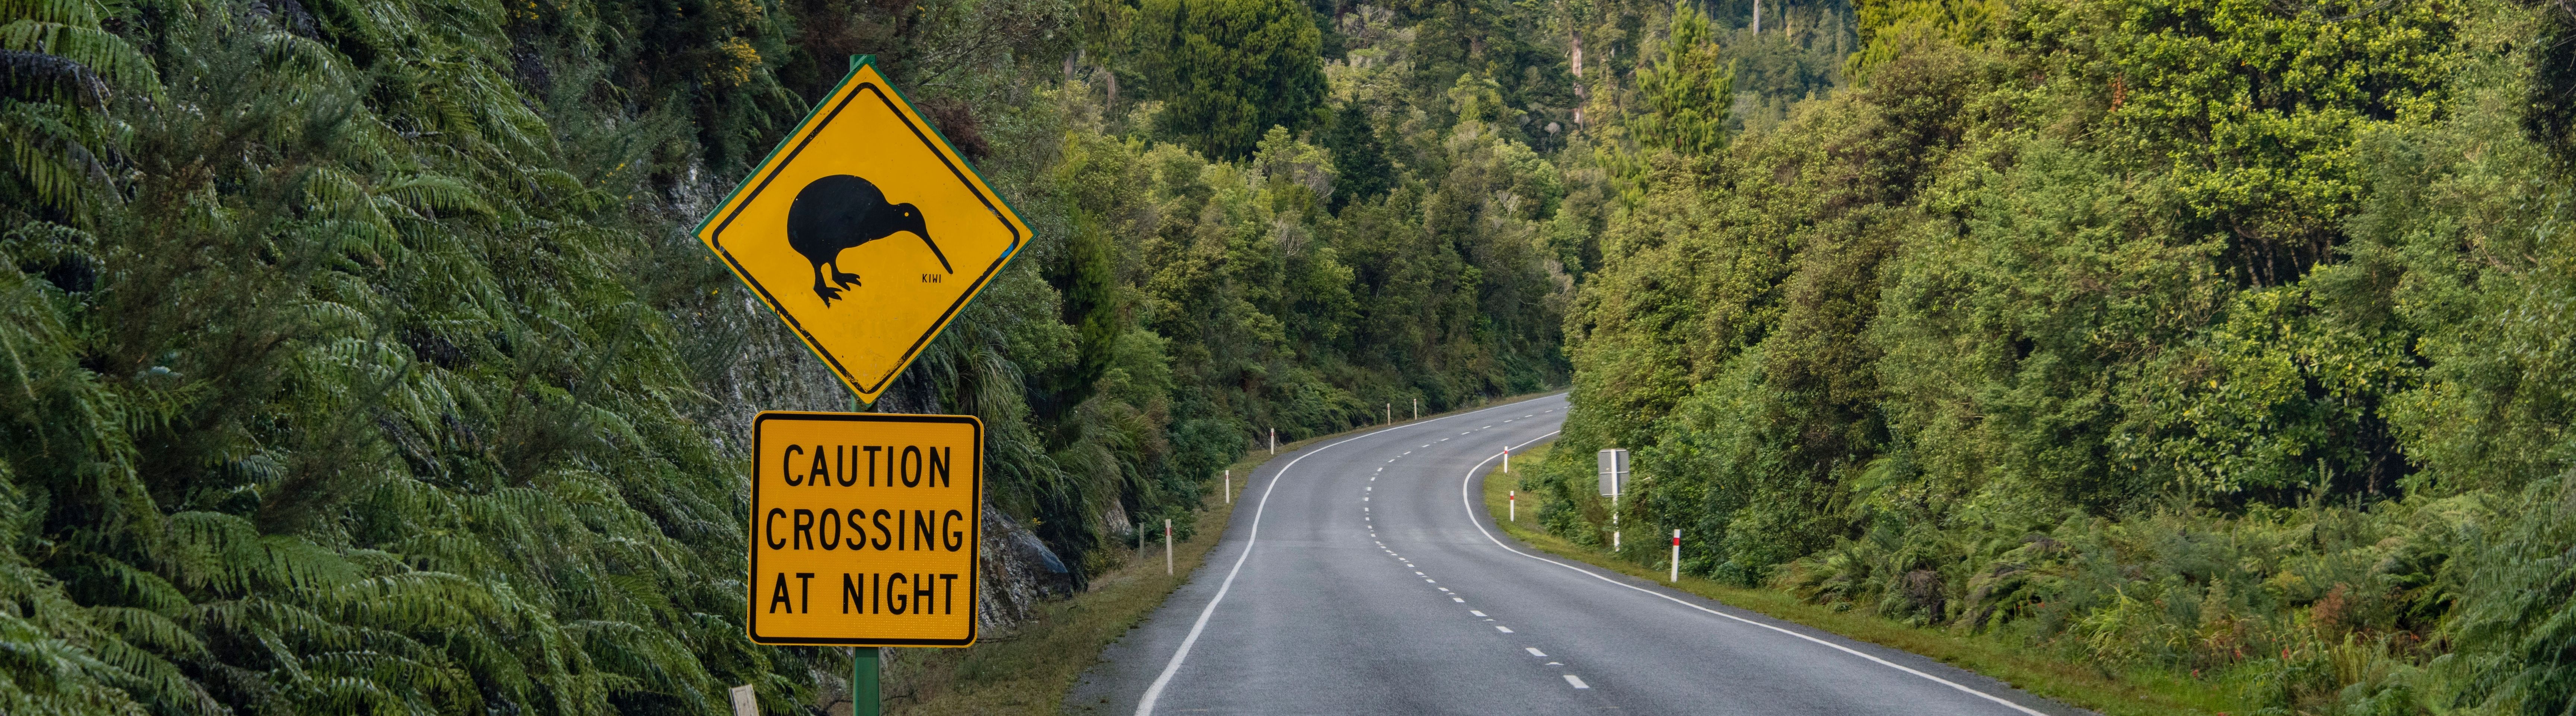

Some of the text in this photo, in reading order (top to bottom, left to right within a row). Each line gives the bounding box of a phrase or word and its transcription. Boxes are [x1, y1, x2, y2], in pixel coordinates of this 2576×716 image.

[922, 273, 941, 283] KIWI
[783, 445, 950, 488] CAUTION
[767, 508, 963, 552] CROSSING
[770, 572, 958, 615] AT NIGHT
